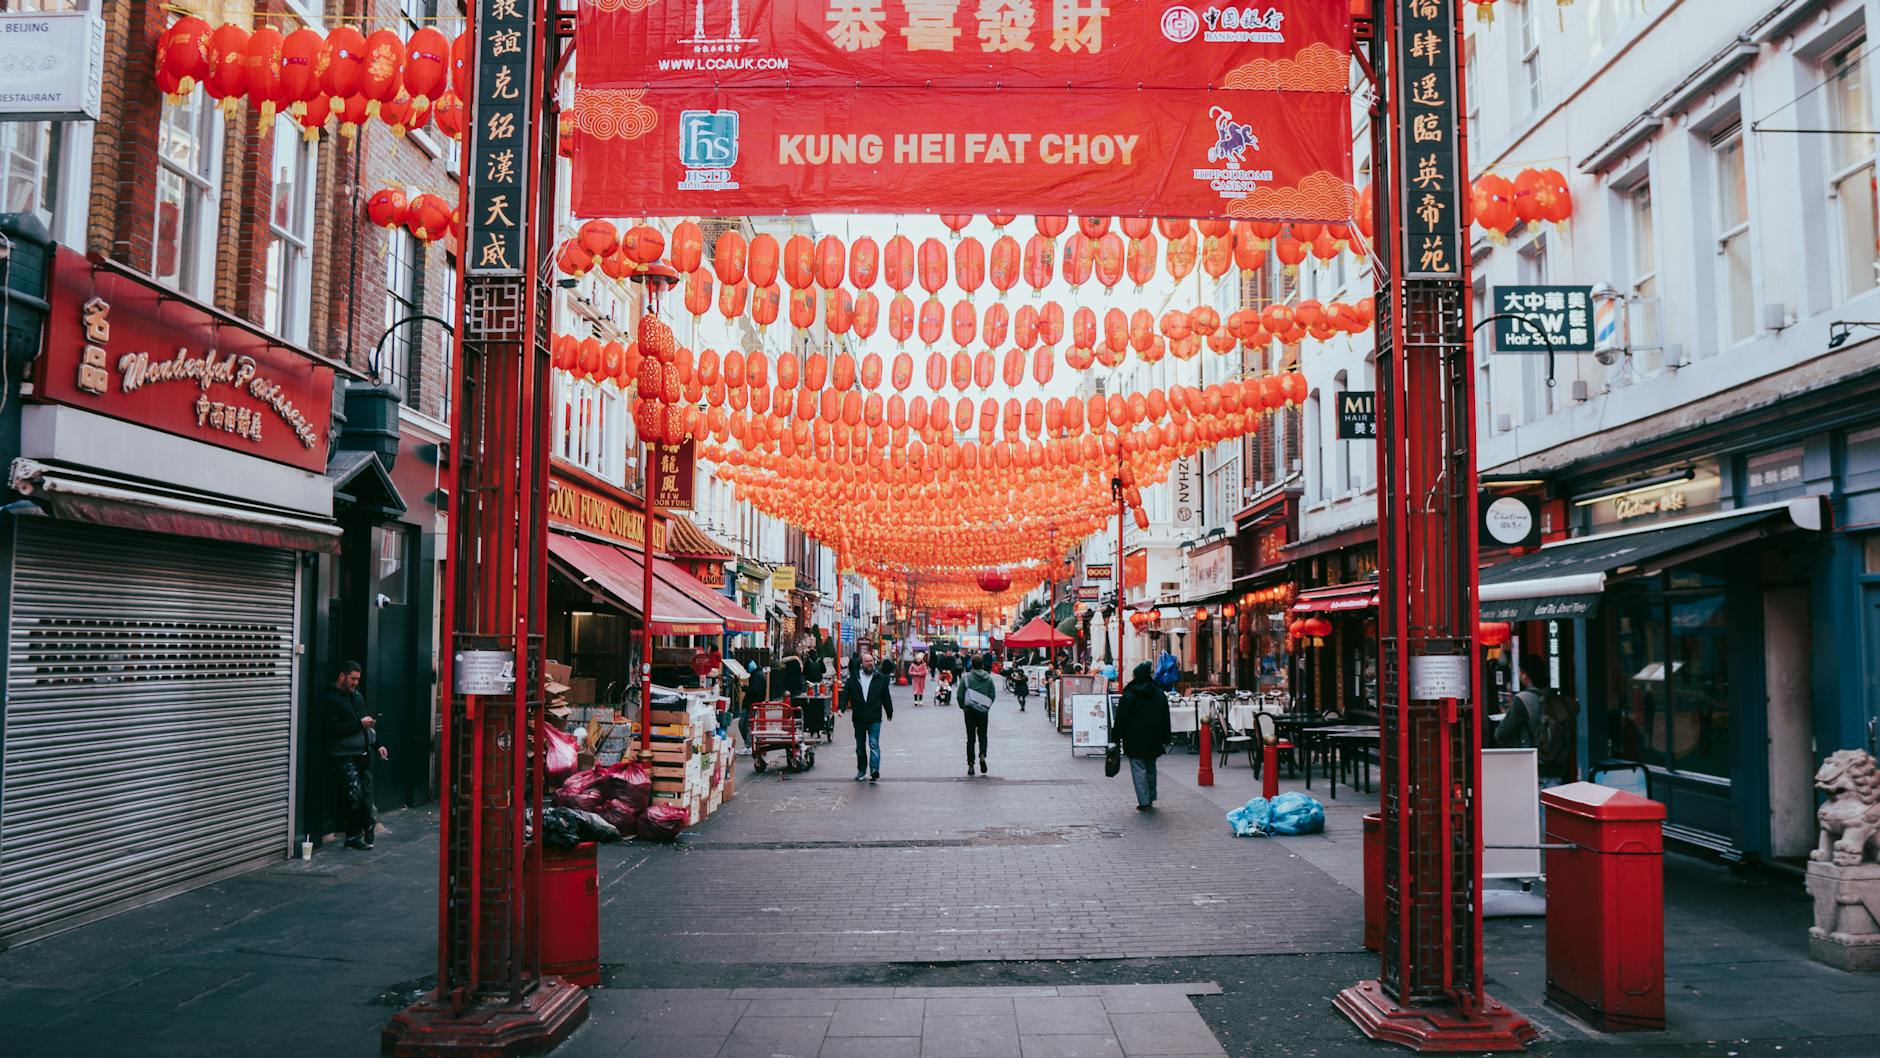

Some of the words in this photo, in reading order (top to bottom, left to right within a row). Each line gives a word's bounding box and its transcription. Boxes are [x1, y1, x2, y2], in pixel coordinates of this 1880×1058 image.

[6, 23, 48, 32] BEIJING
[826, 0, 1110, 54] 恭喜發財
[1206, 32, 1232, 41] BANK
[1235, 32, 1249, 41] OF
[1250, 32, 1283, 41] CHINA
[658, 58, 789, 70] WWW.LCCAUK.COM
[779, 135, 884, 164] KUNG
[894, 134, 955, 163] HEI
[964, 134, 1032, 163] FAT
[1039, 134, 1140, 165] CHOY
[1194, 170, 1272, 180] HIPPODROME
[1211, 181, 1255, 191] CASINO
[1504, 292, 1565, 311] 大中華
[1505, 333, 1530, 345] Hair
[78, 298, 110, 395] 名品
[118, 347, 234, 394] Wonderful
[1344, 396, 1376, 413] MI
[660, 492, 679, 500] NEW
[579, 493, 607, 530] FUNG
[610, 505, 666, 550] SUPERMKET
